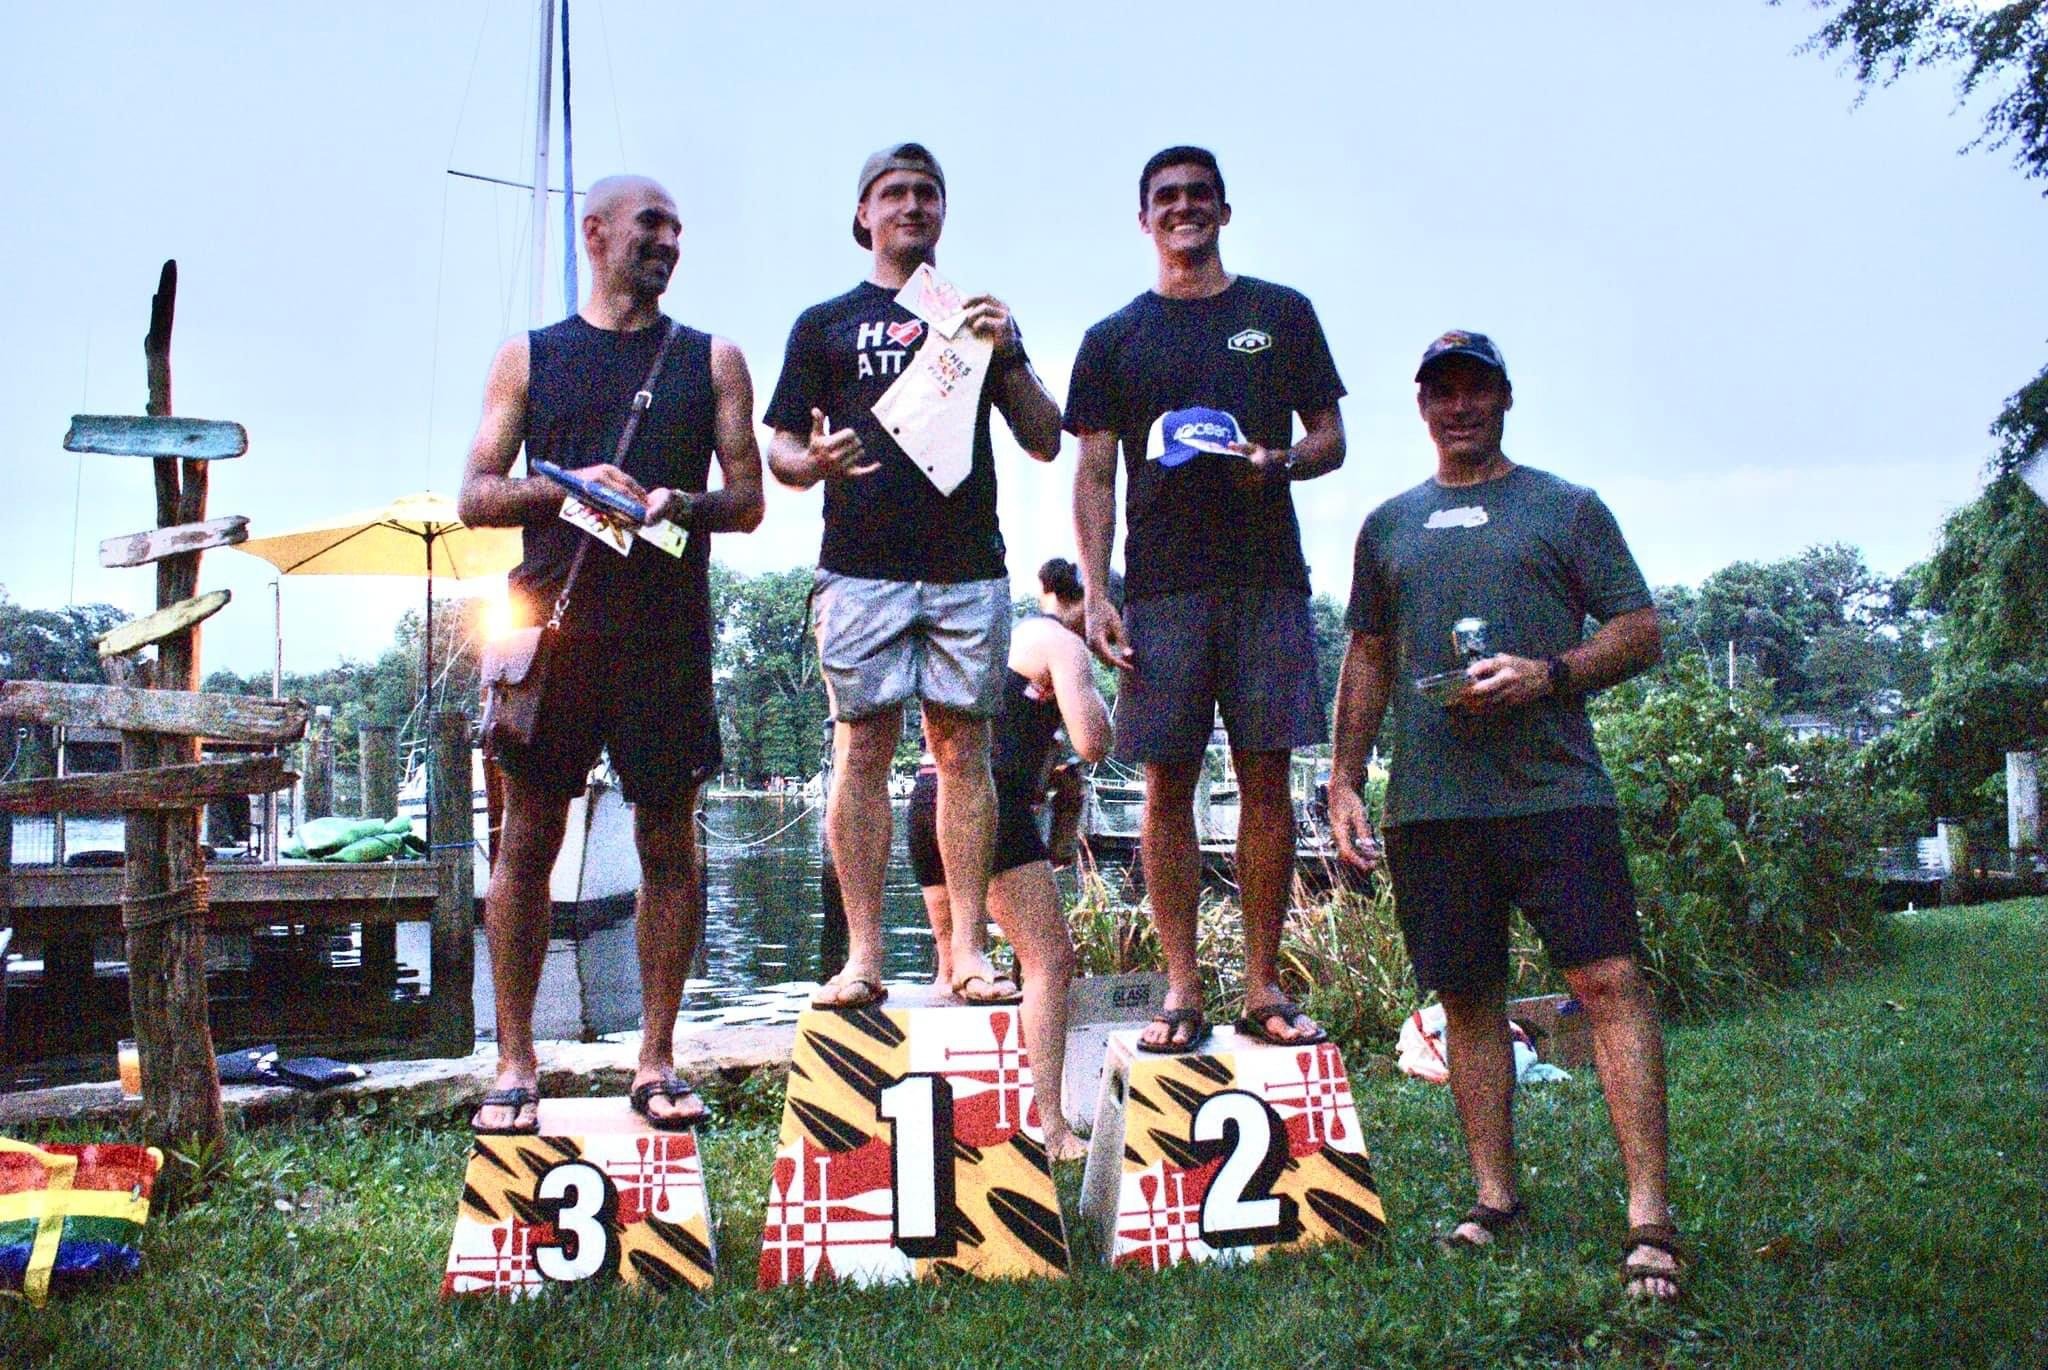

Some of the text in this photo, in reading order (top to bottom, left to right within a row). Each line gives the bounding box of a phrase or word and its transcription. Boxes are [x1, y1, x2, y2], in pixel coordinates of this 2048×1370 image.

[534, 1161, 608, 1283] 3
[880, 1075, 938, 1239] 1
[1192, 1091, 1282, 1234] 2
